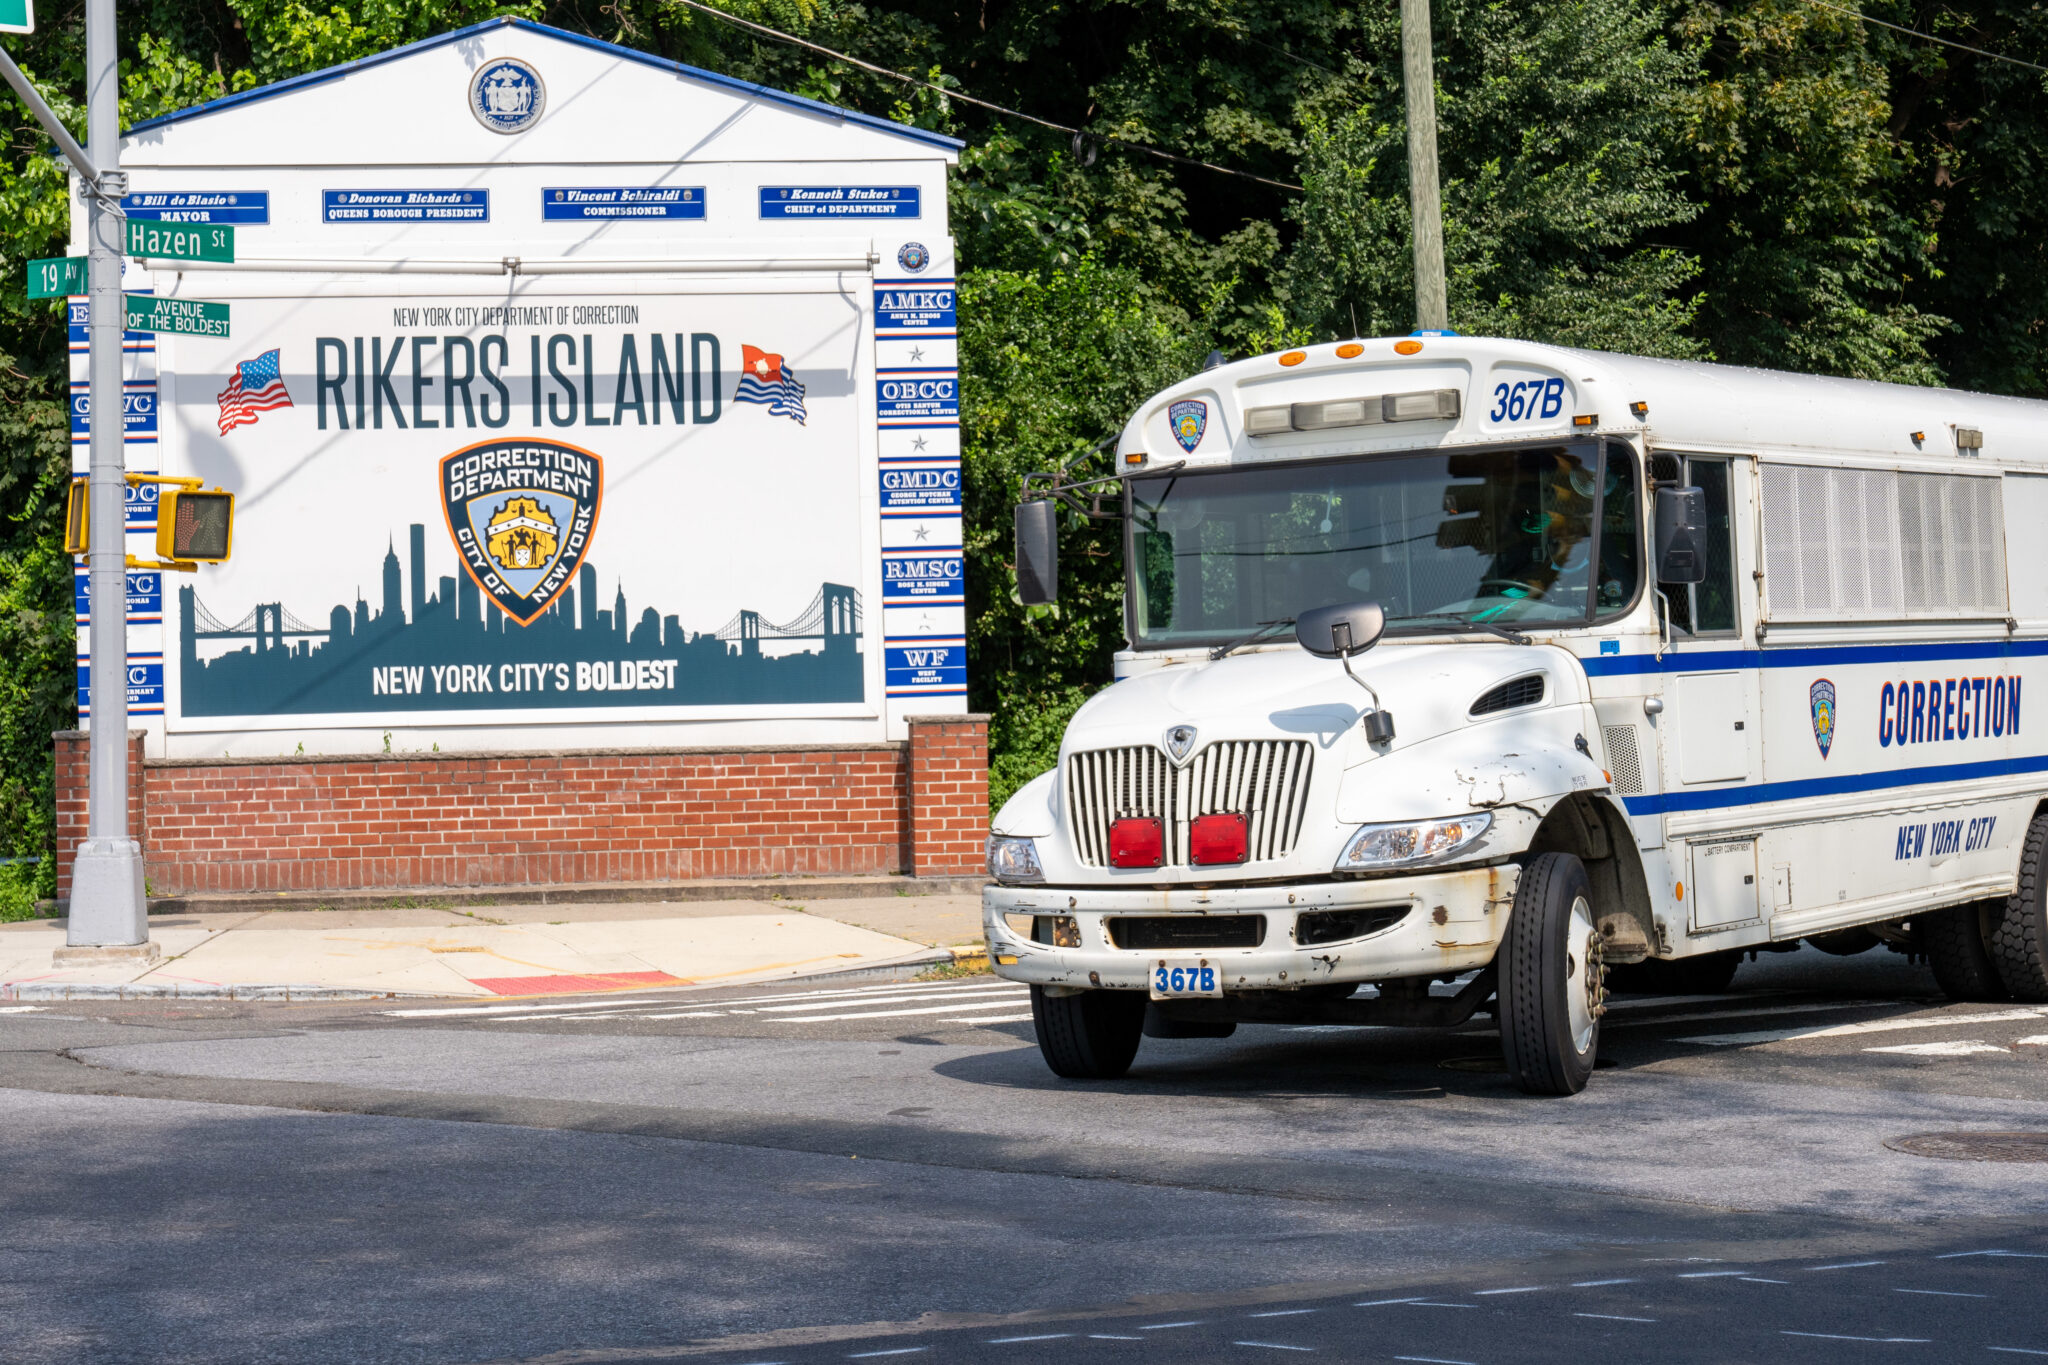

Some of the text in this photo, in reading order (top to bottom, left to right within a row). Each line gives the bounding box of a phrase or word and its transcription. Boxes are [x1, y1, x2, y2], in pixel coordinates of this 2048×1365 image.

[143, 194, 227, 206] Bill de Blasio
[348, 192, 462, 204] Donovan Richards
[567, 190, 680, 201] Vincent Schiraldi
[790, 189, 889, 200] Kenneth Stukes
[160, 211, 210, 222] MAYOR
[328, 208, 484, 219] QUEENS BOROUGH PRESIDENT
[583, 206, 667, 216] COMMISSIONER
[784, 204, 897, 214] CHIEF of DEPARTMENT
[132, 224, 225, 256] Hazen St
[41, 263, 77, 292] 19 Av
[154, 300, 204, 318] AVENUE
[879, 292, 952, 310] AMKC
[128, 313, 229, 335] OF THE BOLDEST
[393, 305, 639, 327] NEW YORK CITY DEPARTMENT OF CORRECTION
[315, 332, 722, 430] RIKERS ISLAND
[882, 381, 953, 400] OBCC
[1490, 377, 1565, 423] 367B
[450, 448, 592, 482] CORRECTION
[450, 468, 592, 502] DEPARTMENT
[883, 470, 959, 489] GMDC
[457, 505, 592, 603] CITY OF NEW YORK
[885, 560, 960, 578] RMSC
[903, 649, 949, 667] WF
[372, 659, 678, 695] NEW YORK CITY'S BOLDEST
[1879, 675, 2022, 748] CORRECTION
[1895, 816, 1997, 861] NEW YORK CITY
[1707, 842, 1751, 856] BATTERY COMPARTMENT
[1155, 967, 1216, 992] 367B
